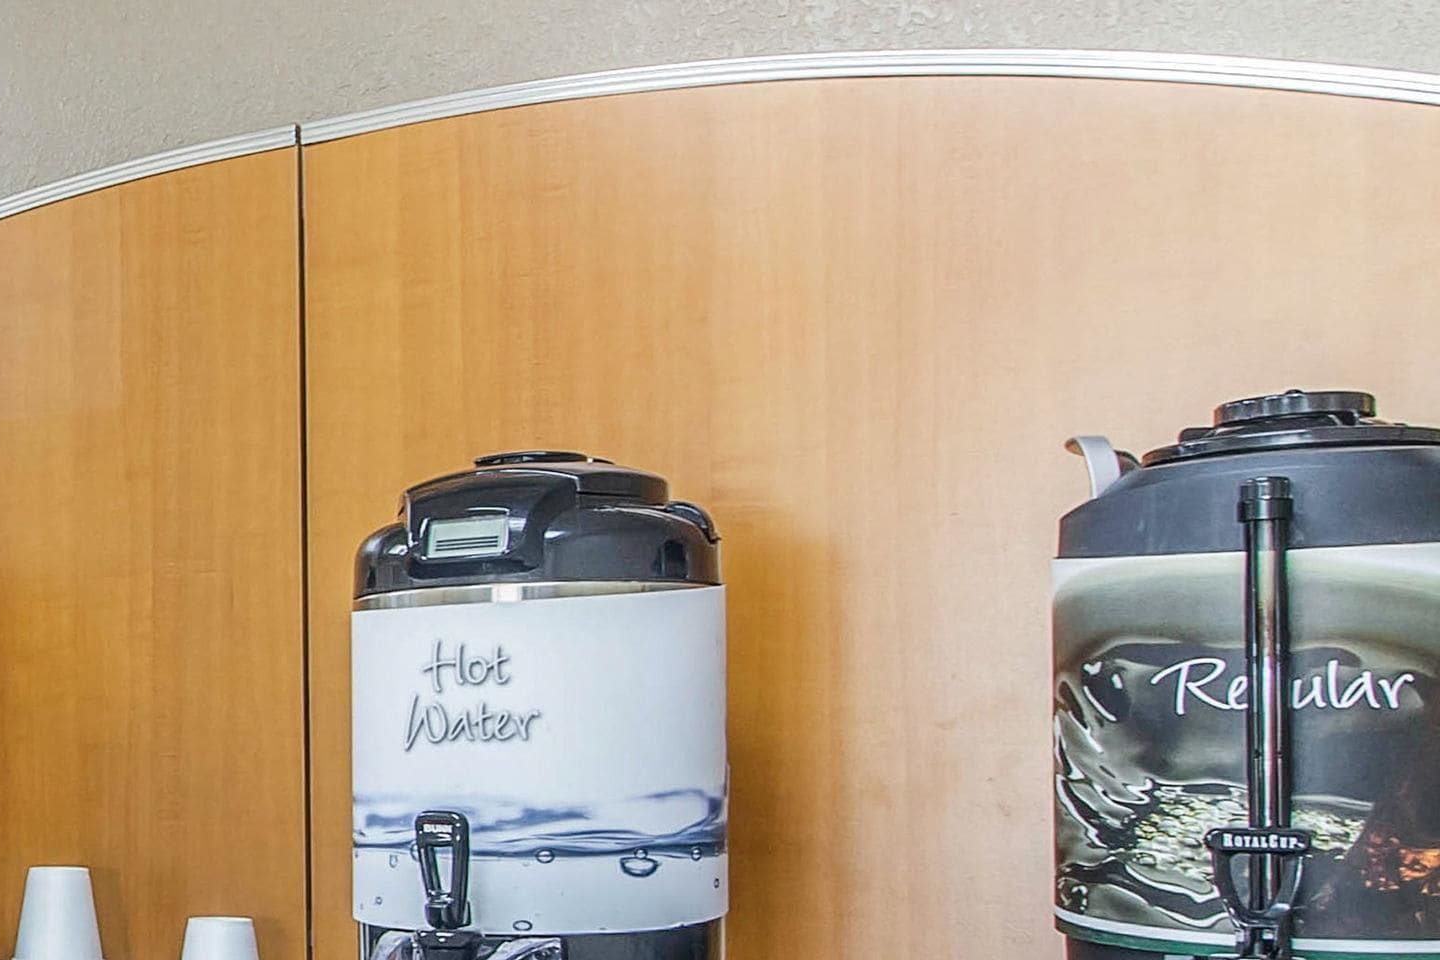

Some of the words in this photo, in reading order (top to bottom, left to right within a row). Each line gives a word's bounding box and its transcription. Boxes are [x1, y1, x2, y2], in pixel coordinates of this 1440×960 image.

[422, 639, 512, 693] Hot
[1151, 657, 1414, 715] Reular
[405, 694, 542, 752] Water
